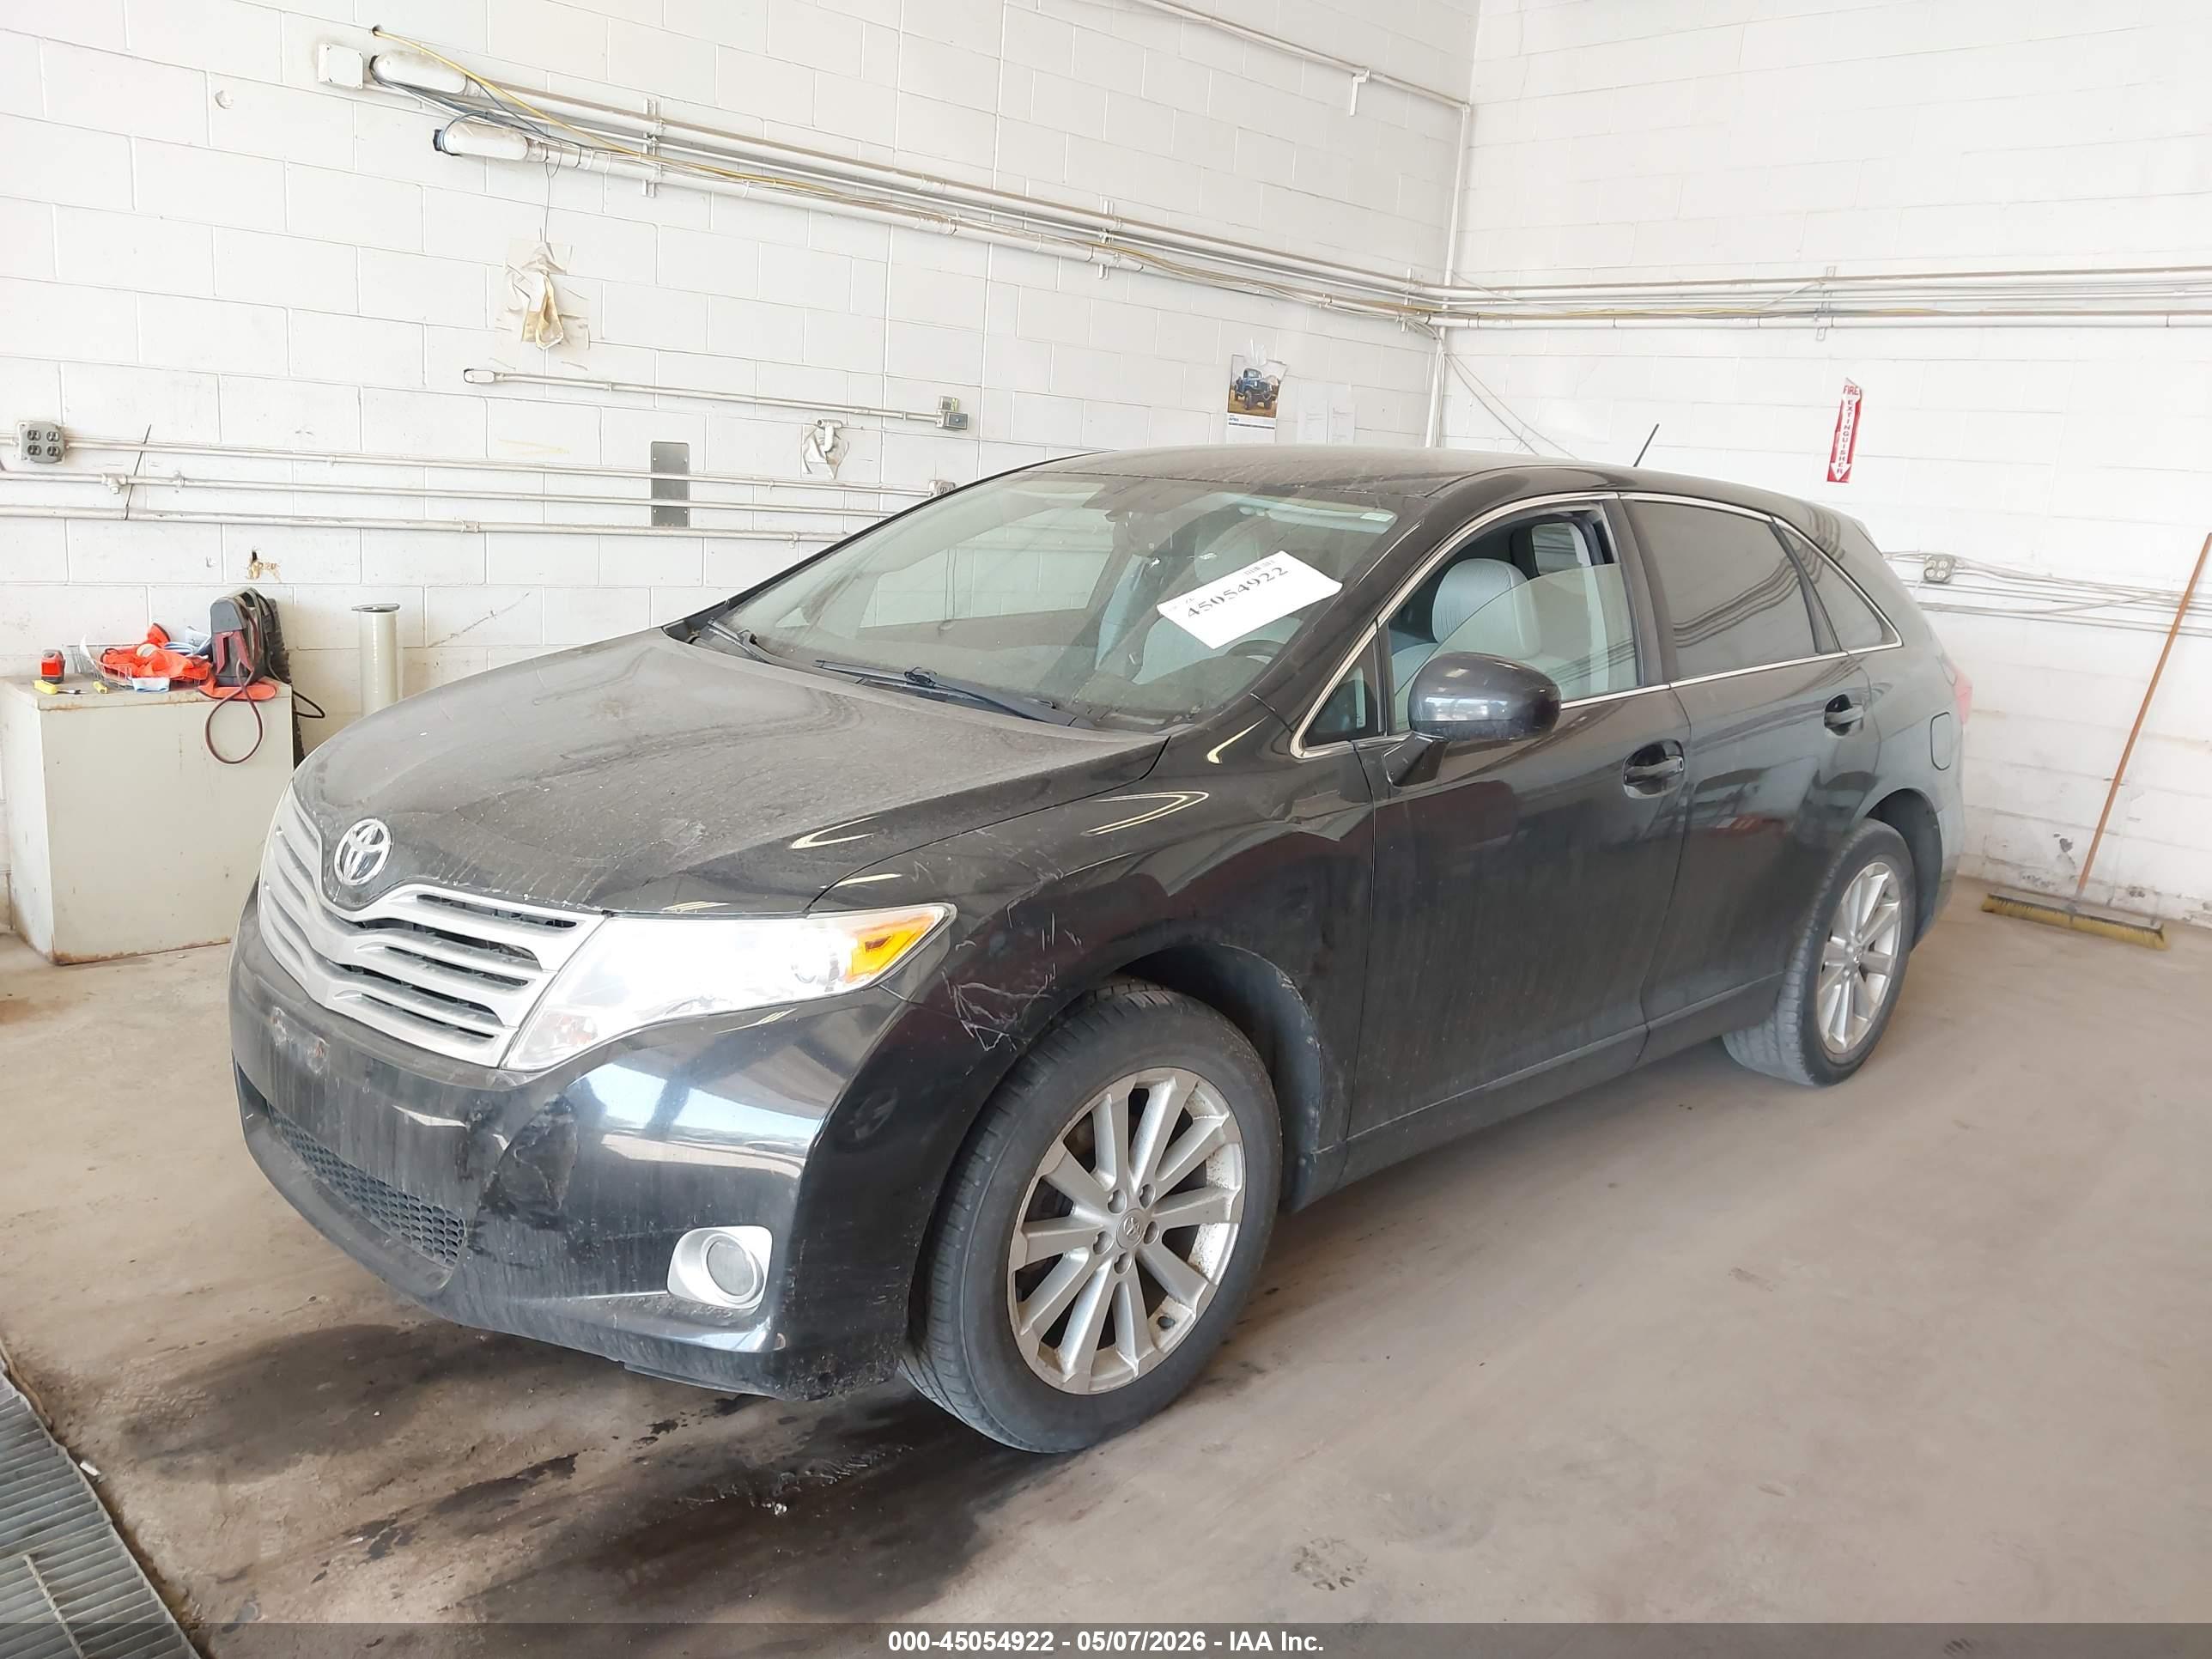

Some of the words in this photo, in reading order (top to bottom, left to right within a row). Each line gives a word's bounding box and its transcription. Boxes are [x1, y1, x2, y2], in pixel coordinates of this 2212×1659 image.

[1843, 385, 1859, 395] FIRE
[1836, 399, 1854, 474] EXTINGUISHER
[1188, 566, 1289, 617] 45054922
